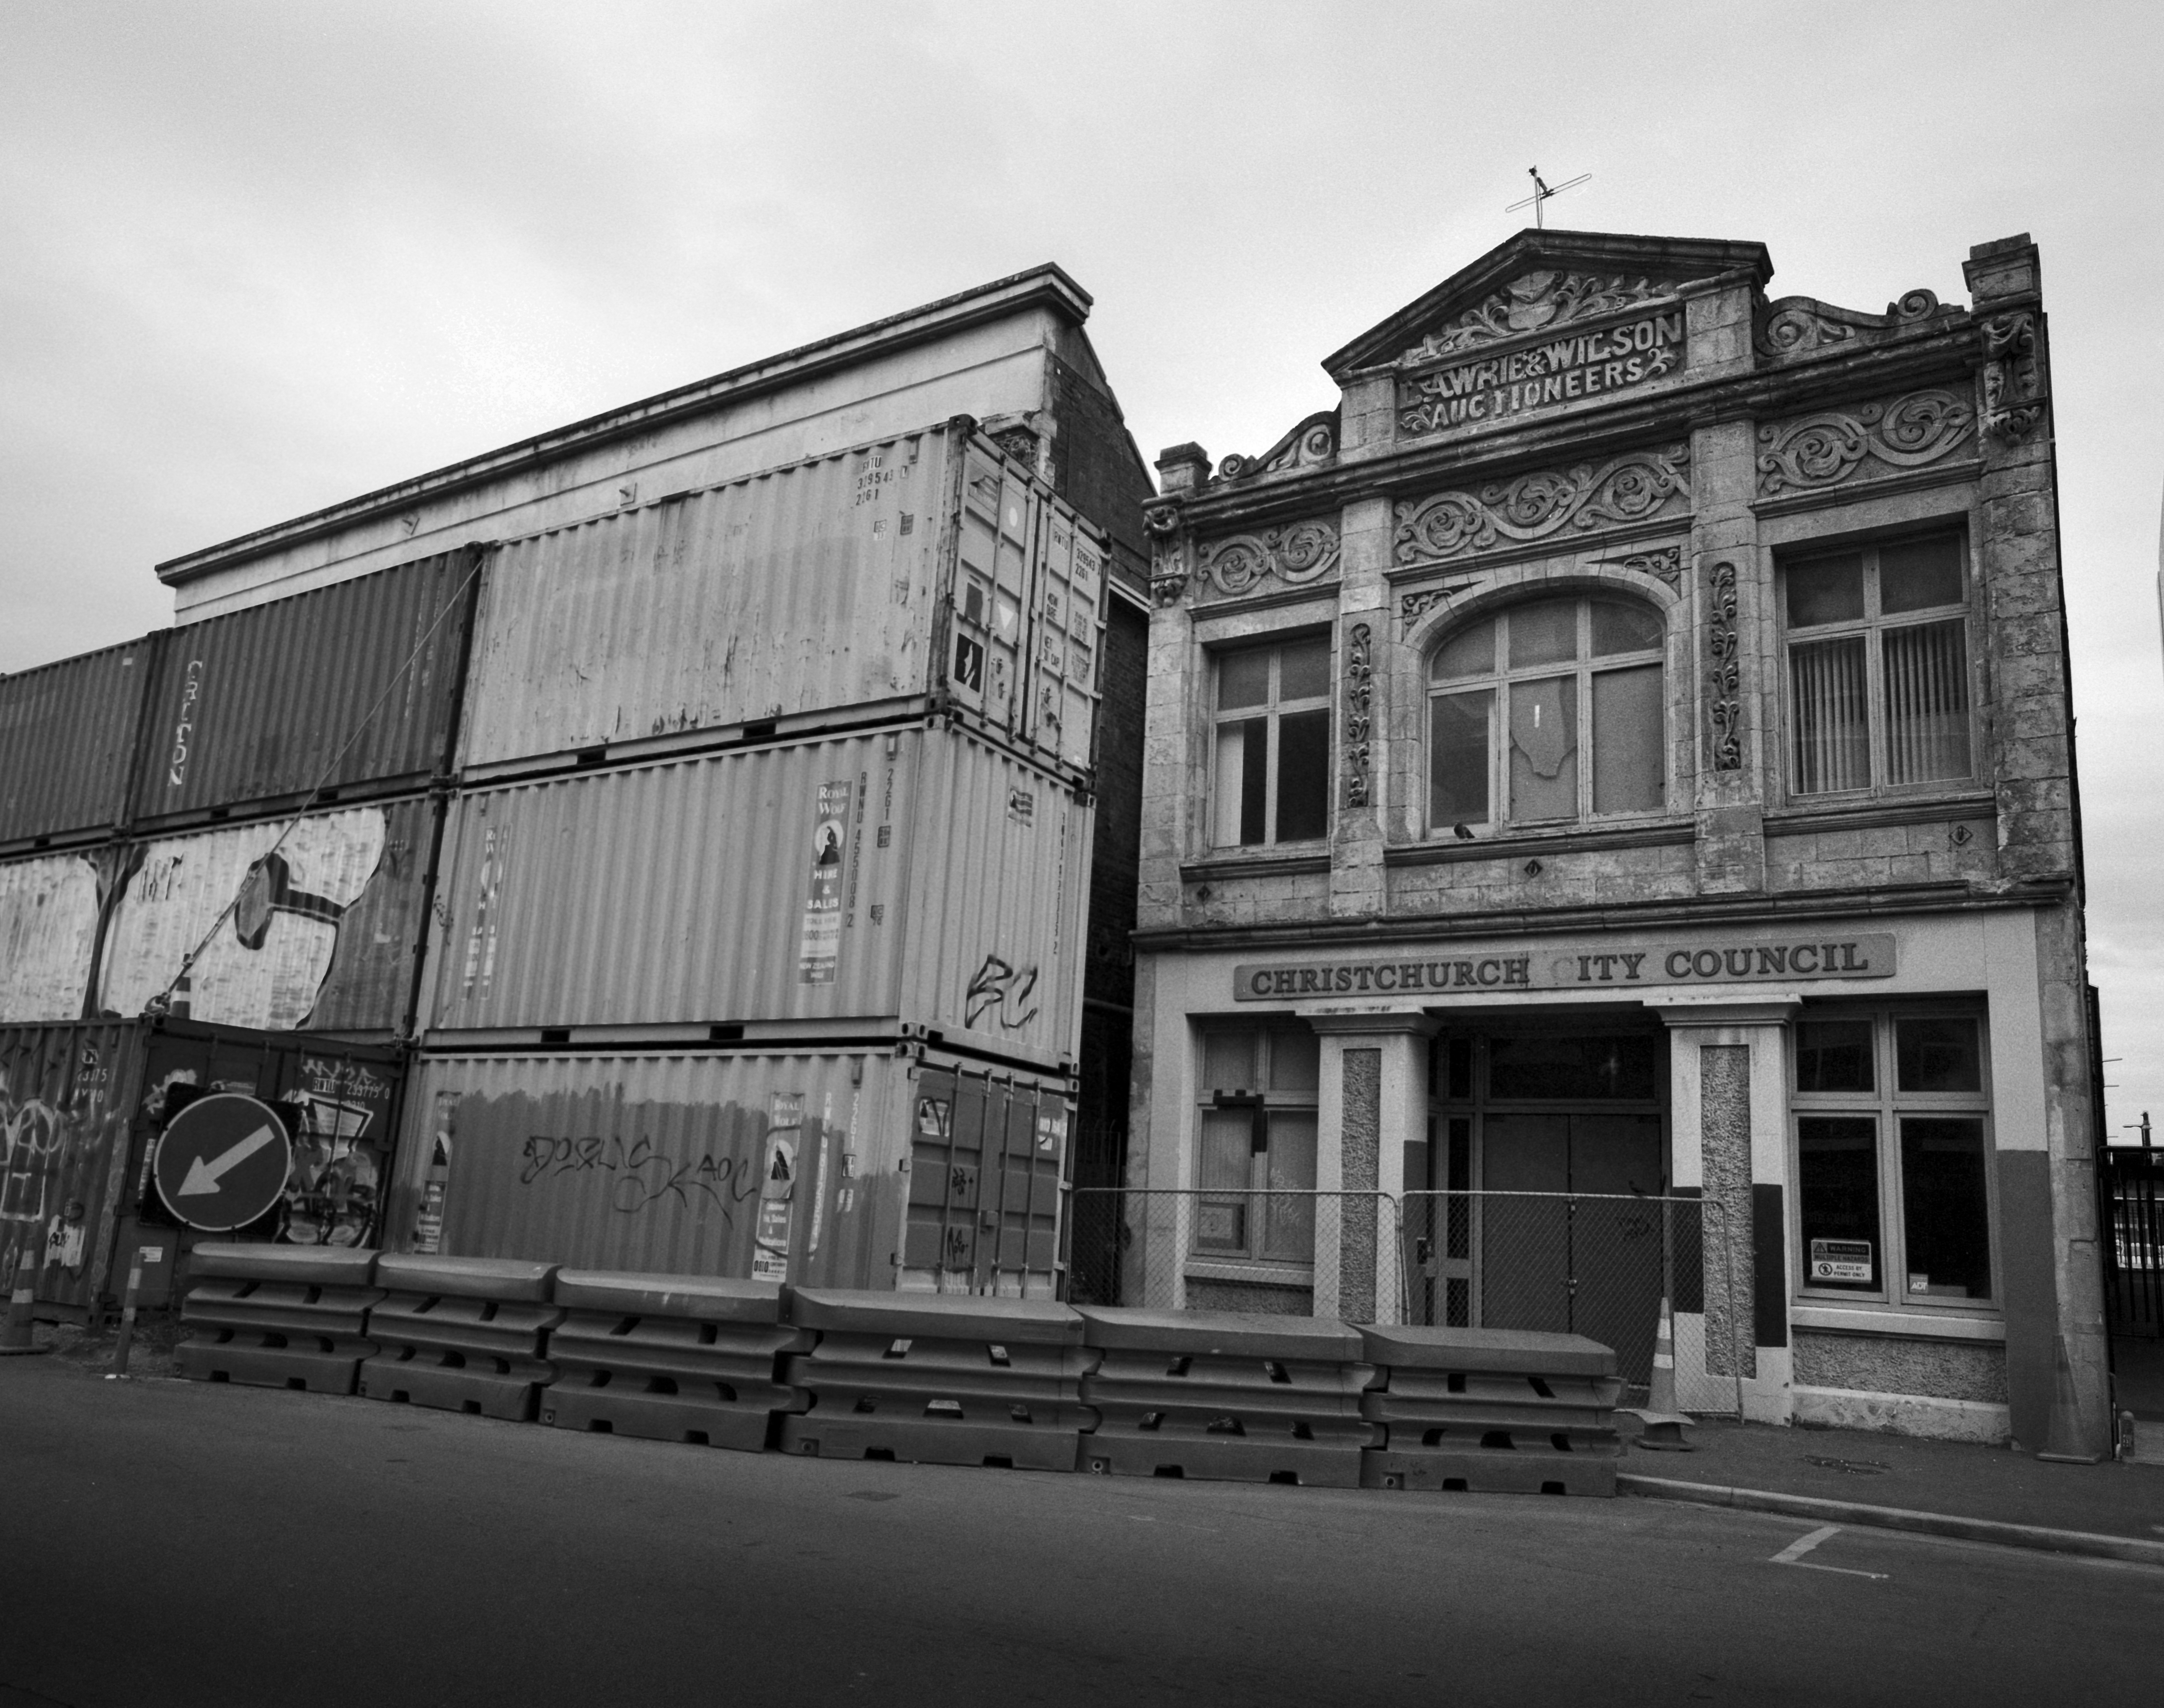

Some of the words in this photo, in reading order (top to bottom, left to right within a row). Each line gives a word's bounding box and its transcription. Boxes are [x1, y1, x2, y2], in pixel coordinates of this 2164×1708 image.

[1523, 351, 1545, 376] &
[1537, 312, 1682, 372] WILSON
[1431, 358, 1643, 428] AUCTIONEERS
[885, 767, 894, 820] 2261
[1251, 958, 1530, 995] CHRISTCHURCH
[1665, 942, 1868, 978] COUNCIL
[850, 1092, 860, 1149] 2261
[1910, 1282, 1927, 1290] ADT
